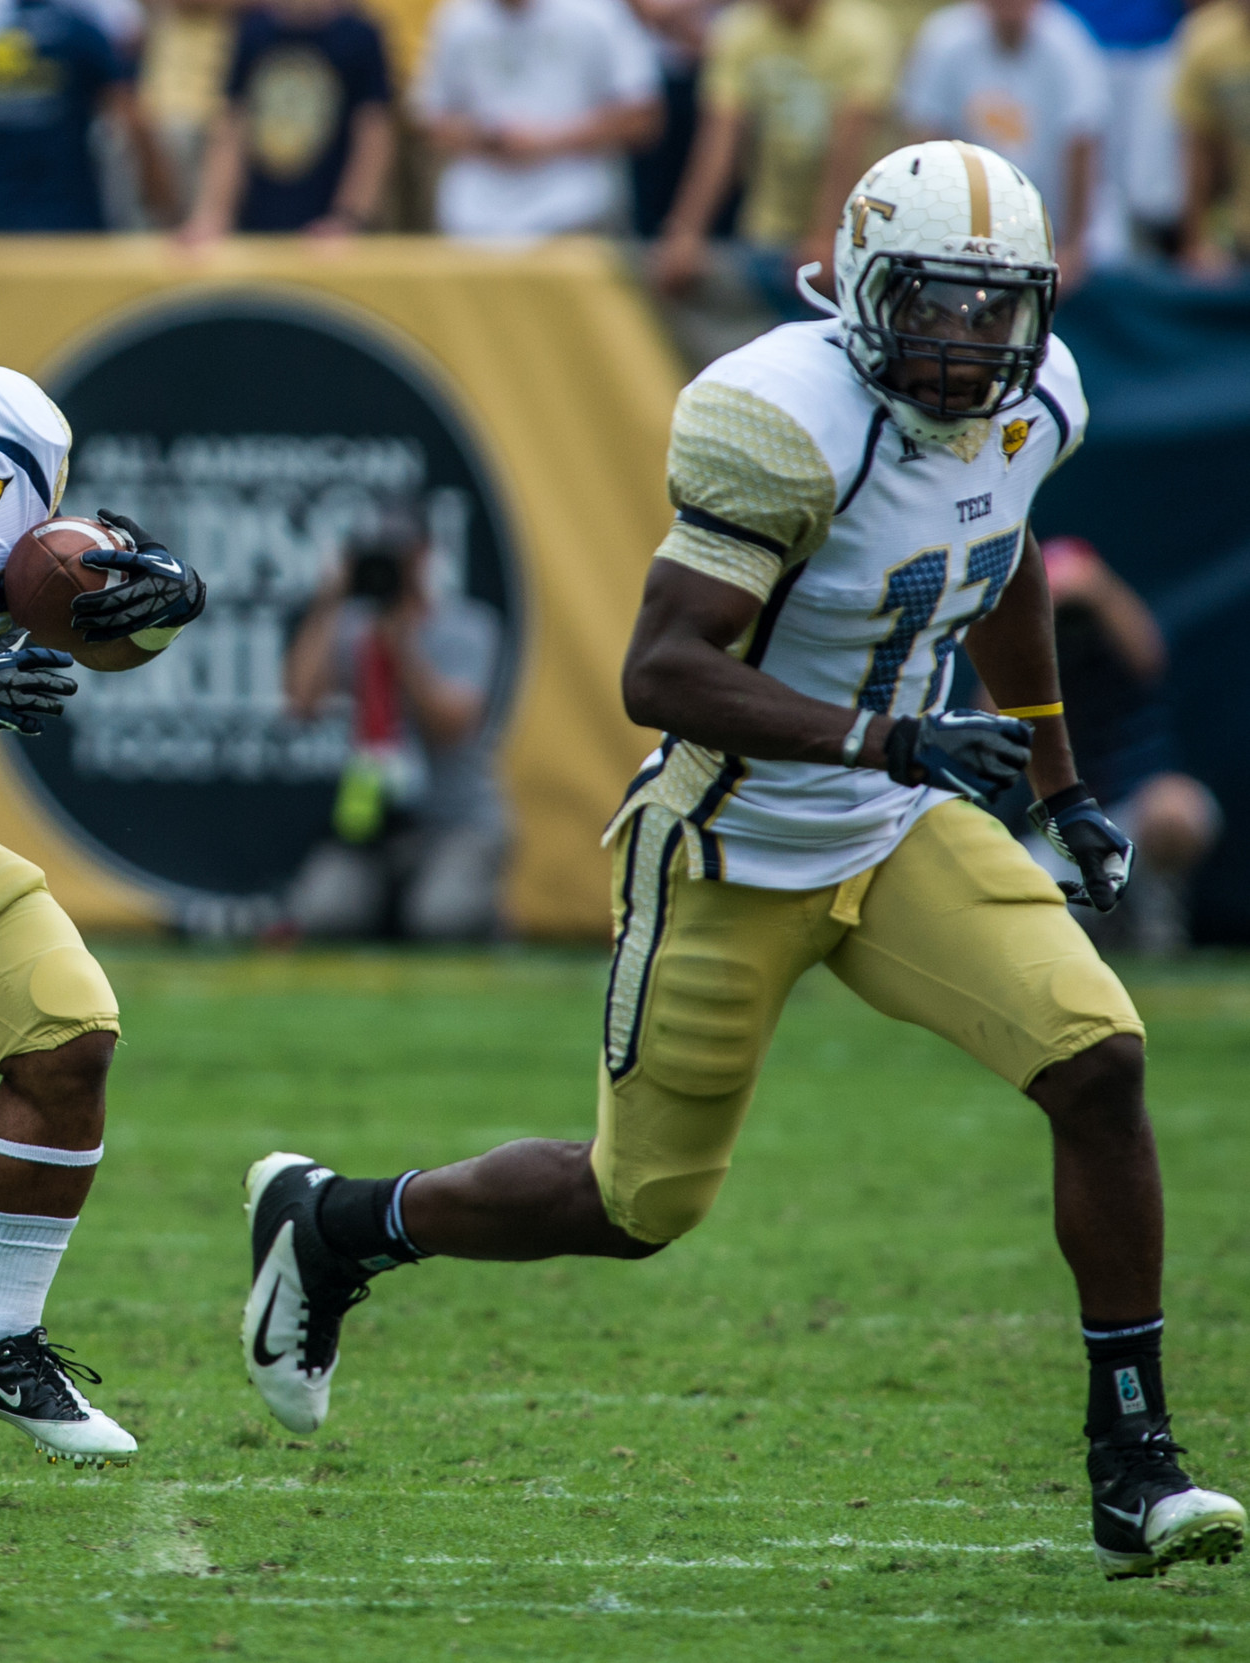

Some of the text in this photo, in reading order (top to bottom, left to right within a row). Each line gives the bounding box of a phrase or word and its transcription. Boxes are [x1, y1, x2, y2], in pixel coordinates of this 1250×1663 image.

[961, 241, 998, 255] ACC
[1004, 426, 1025, 444] ACC
[955, 492, 992, 522] TECH
